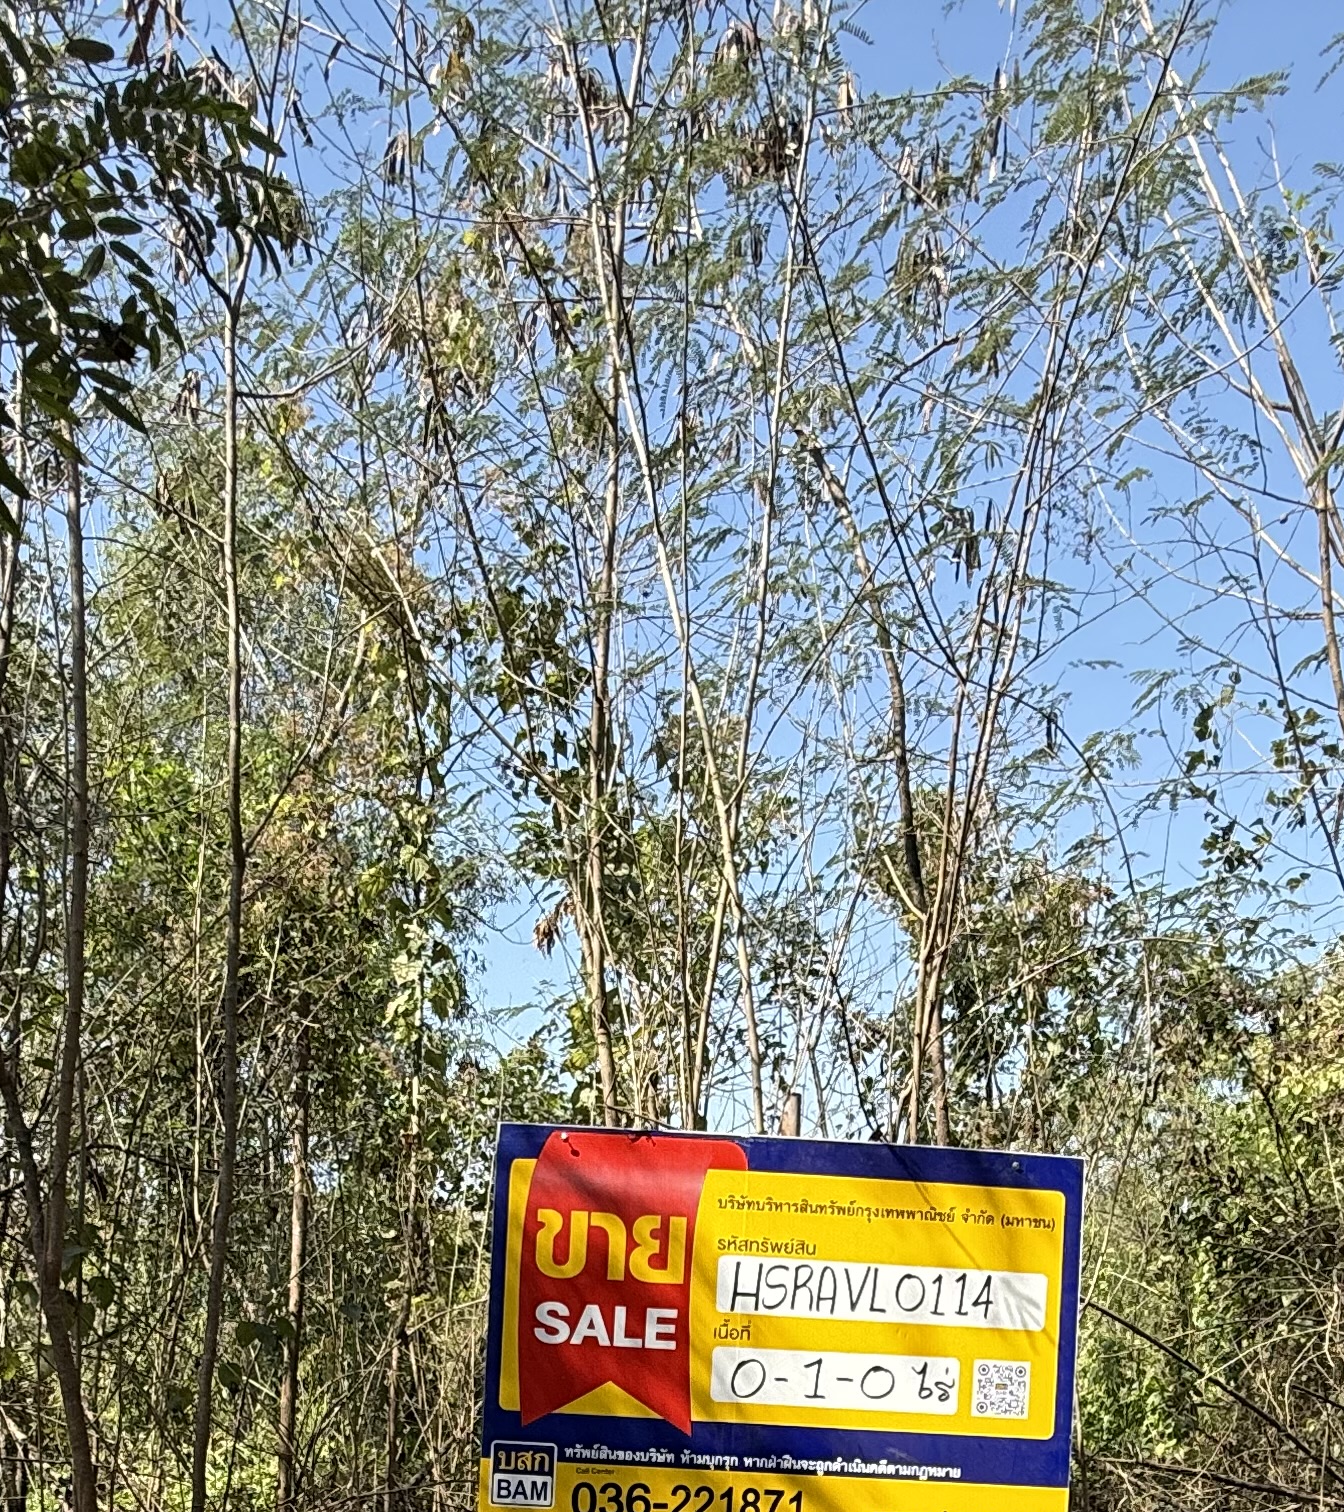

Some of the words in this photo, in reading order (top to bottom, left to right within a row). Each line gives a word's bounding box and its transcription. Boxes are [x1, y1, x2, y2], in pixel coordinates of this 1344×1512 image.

[718, 1194, 956, 1223] บริษัทบริหารสินทรัพย์กรุงเทพพาณิชย์
[961, 1208, 995, 1225] จำกัด
[1000, 1213, 1055, 1232] (มหาชน)
[535, 1208, 687, 1284] ขาย
[717, 1235, 817, 1256] รหัสทรัพย์สิน
[534, 1301, 678, 1350] SALE
[713, 1319, 752, 1341] เนื้อที่
[731, 1358, 895, 1399] 0-1-0
[912, 1361, 955, 1402] ไร่
[497, 1450, 550, 1472] บสก
[564, 1444, 675, 1463] ทรัพย์สินของบริษัท
[680, 1449, 739, 1471] ห้ามบุกรุก
[496, 1478, 548, 1501] BAM
